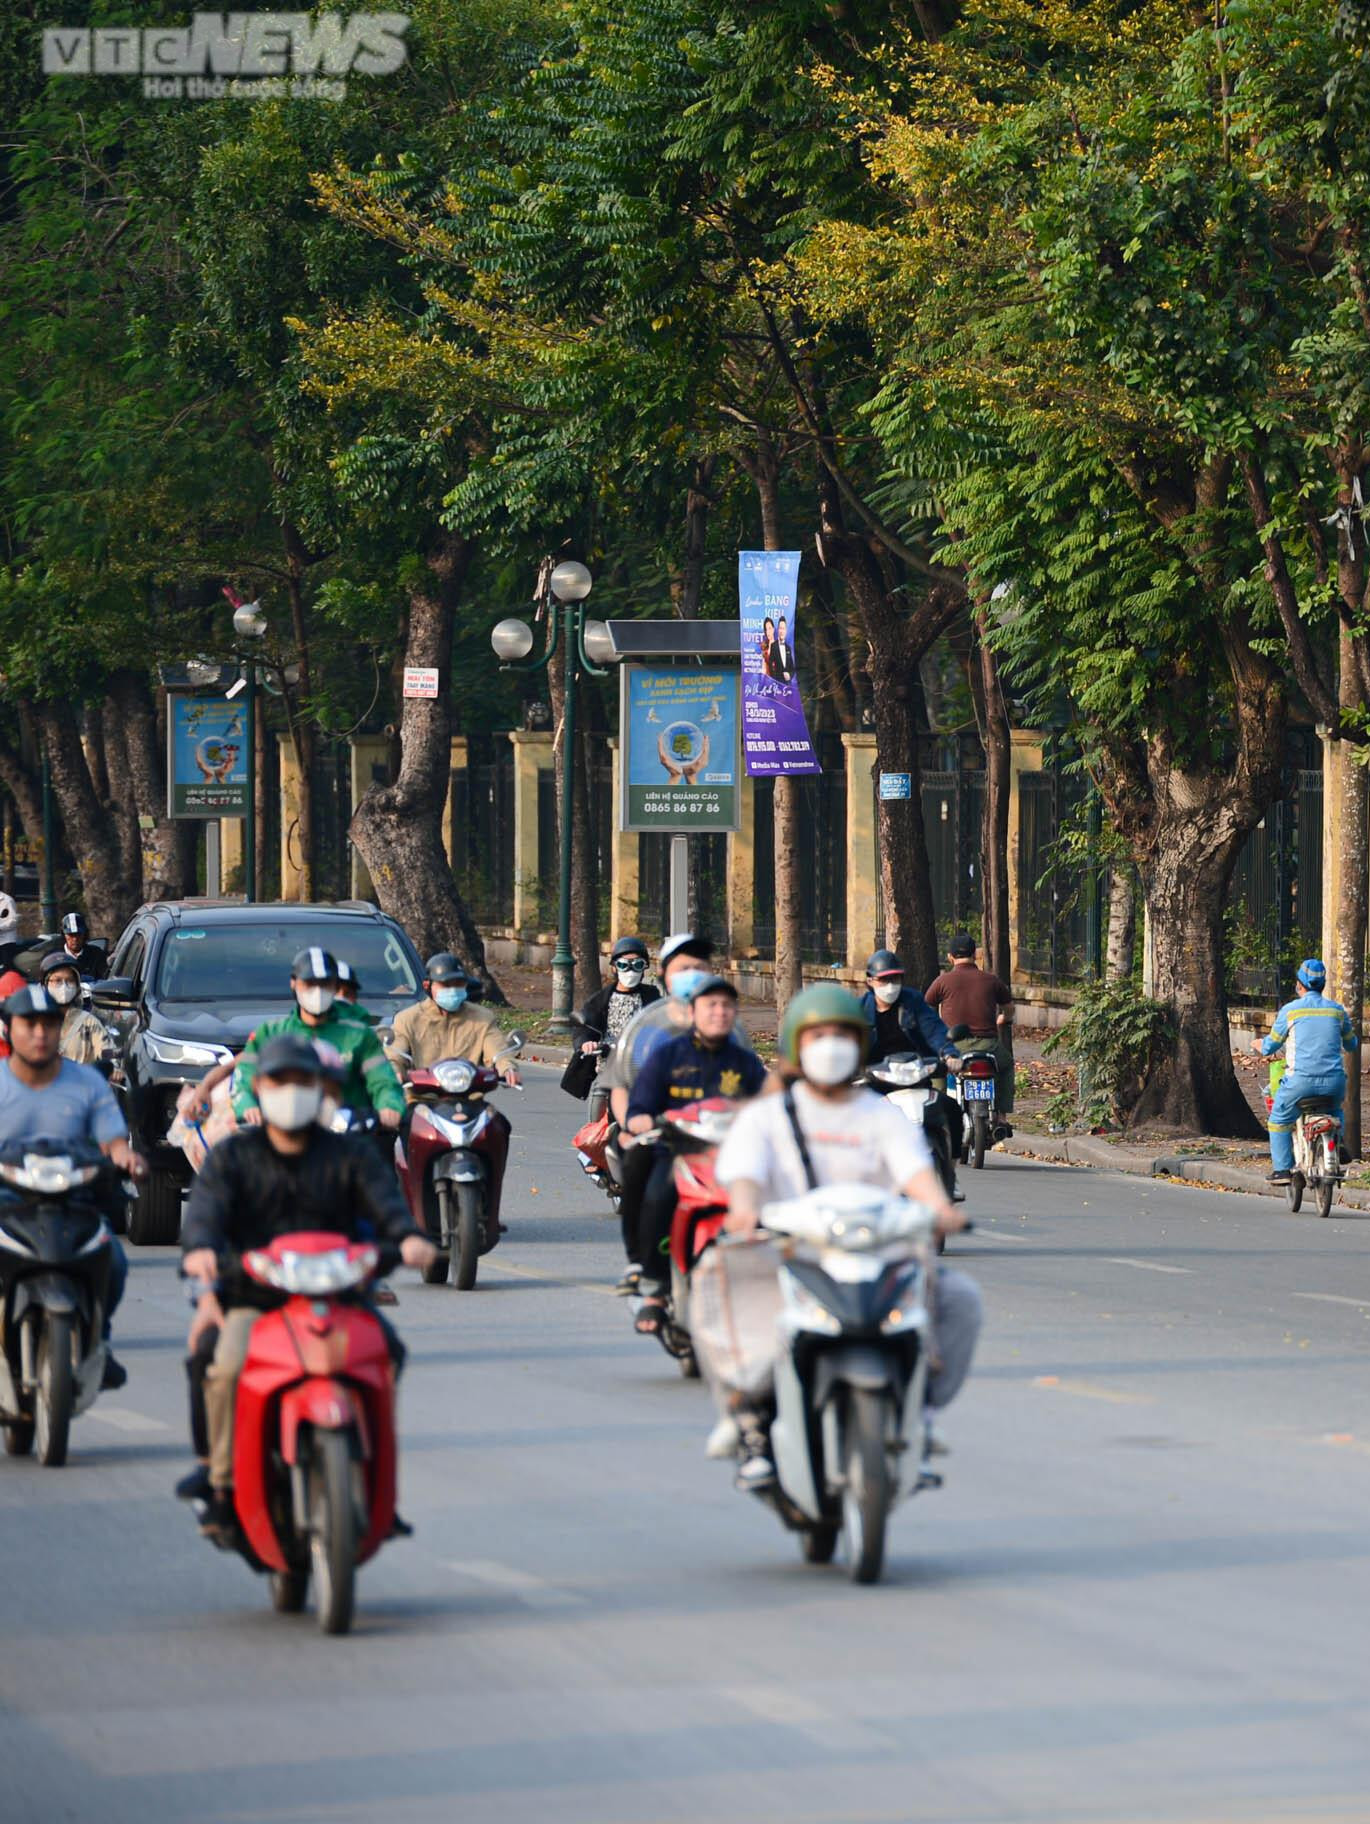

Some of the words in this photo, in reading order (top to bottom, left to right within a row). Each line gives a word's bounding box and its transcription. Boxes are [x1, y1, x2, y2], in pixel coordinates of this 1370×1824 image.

[644, 803, 671, 813] 0865
[674, 803, 687, 813] 86
[690, 803, 703, 813] 87
[706, 803, 720, 813] 86
